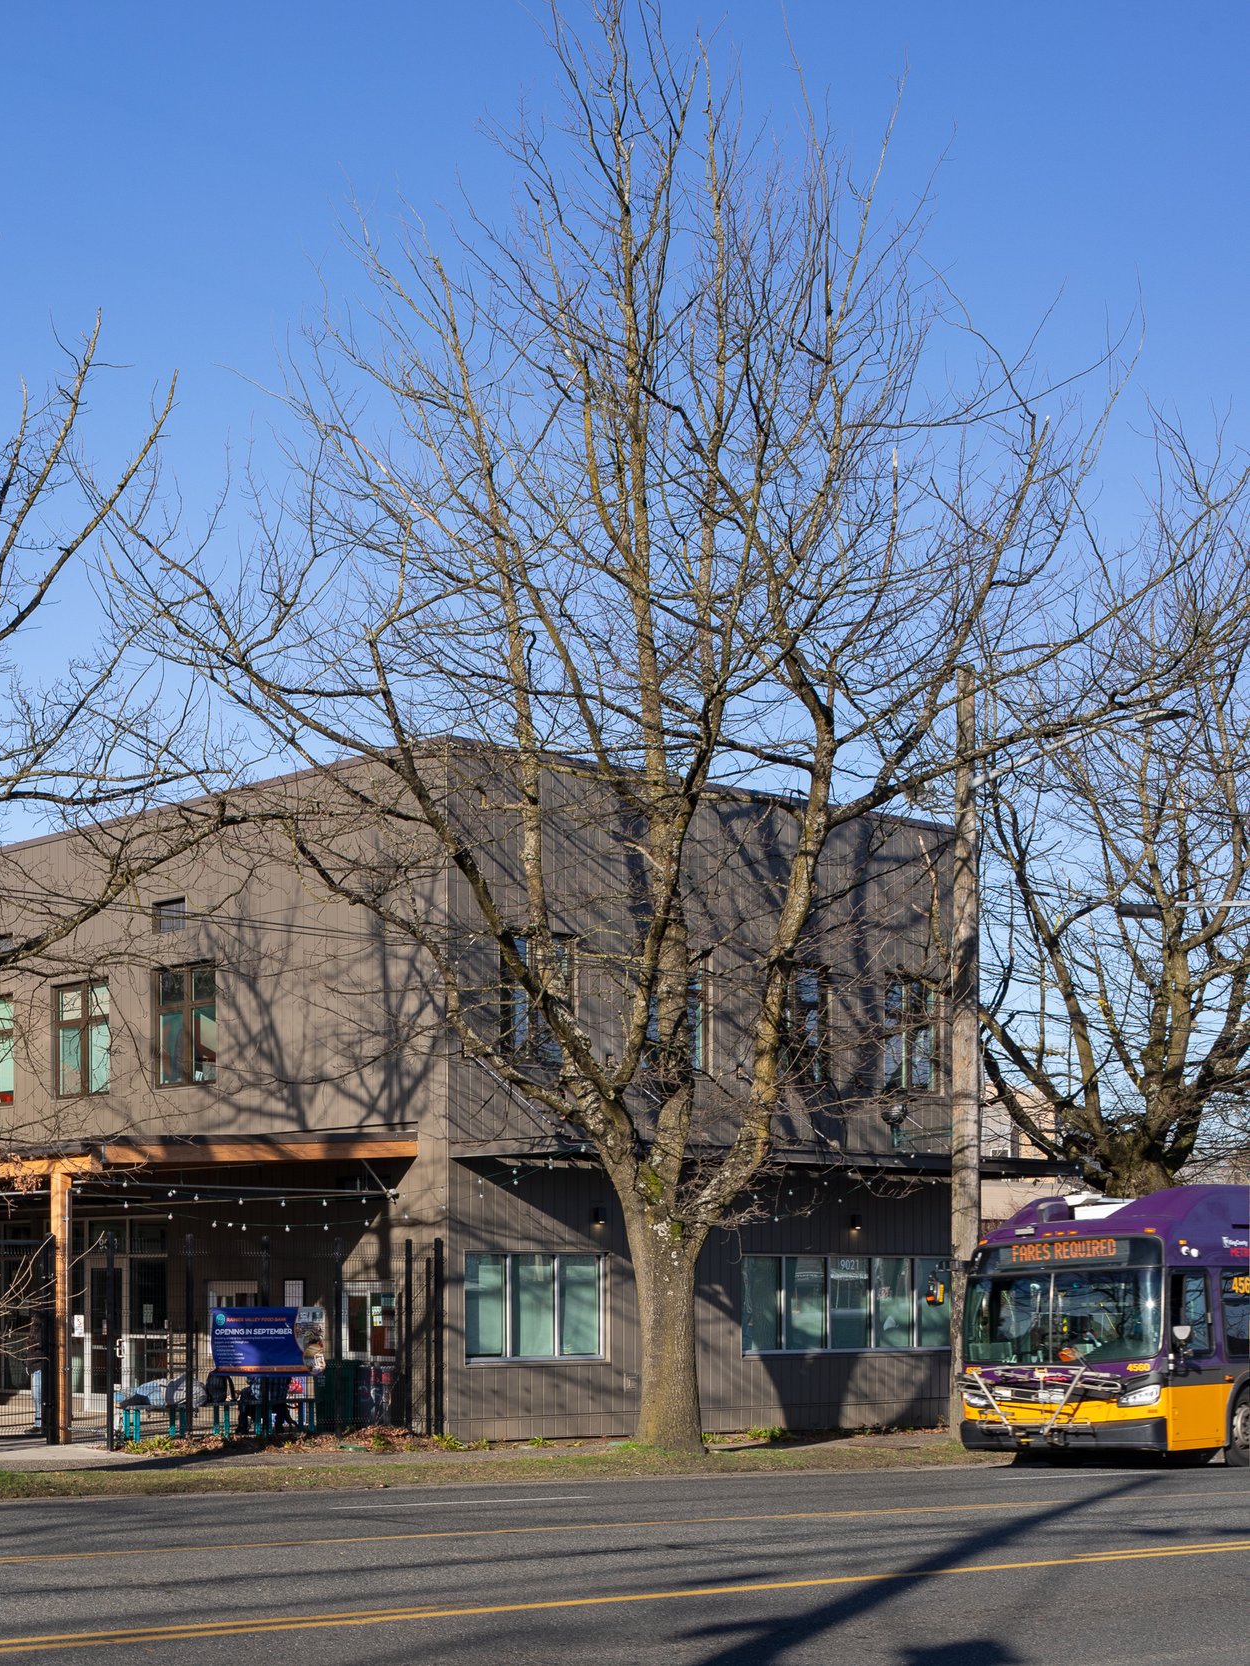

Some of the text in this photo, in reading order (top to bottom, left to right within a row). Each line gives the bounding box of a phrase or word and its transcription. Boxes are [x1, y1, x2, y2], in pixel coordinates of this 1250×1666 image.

[1011, 1238, 1117, 1262] FARES REQUIRED
[840, 1259, 860, 1270] 9021
[214, 1328, 245, 1336] OPENING
[253, 1327, 293, 1335] SEPTEMBER
[1126, 1363, 1151, 1372] 4560
